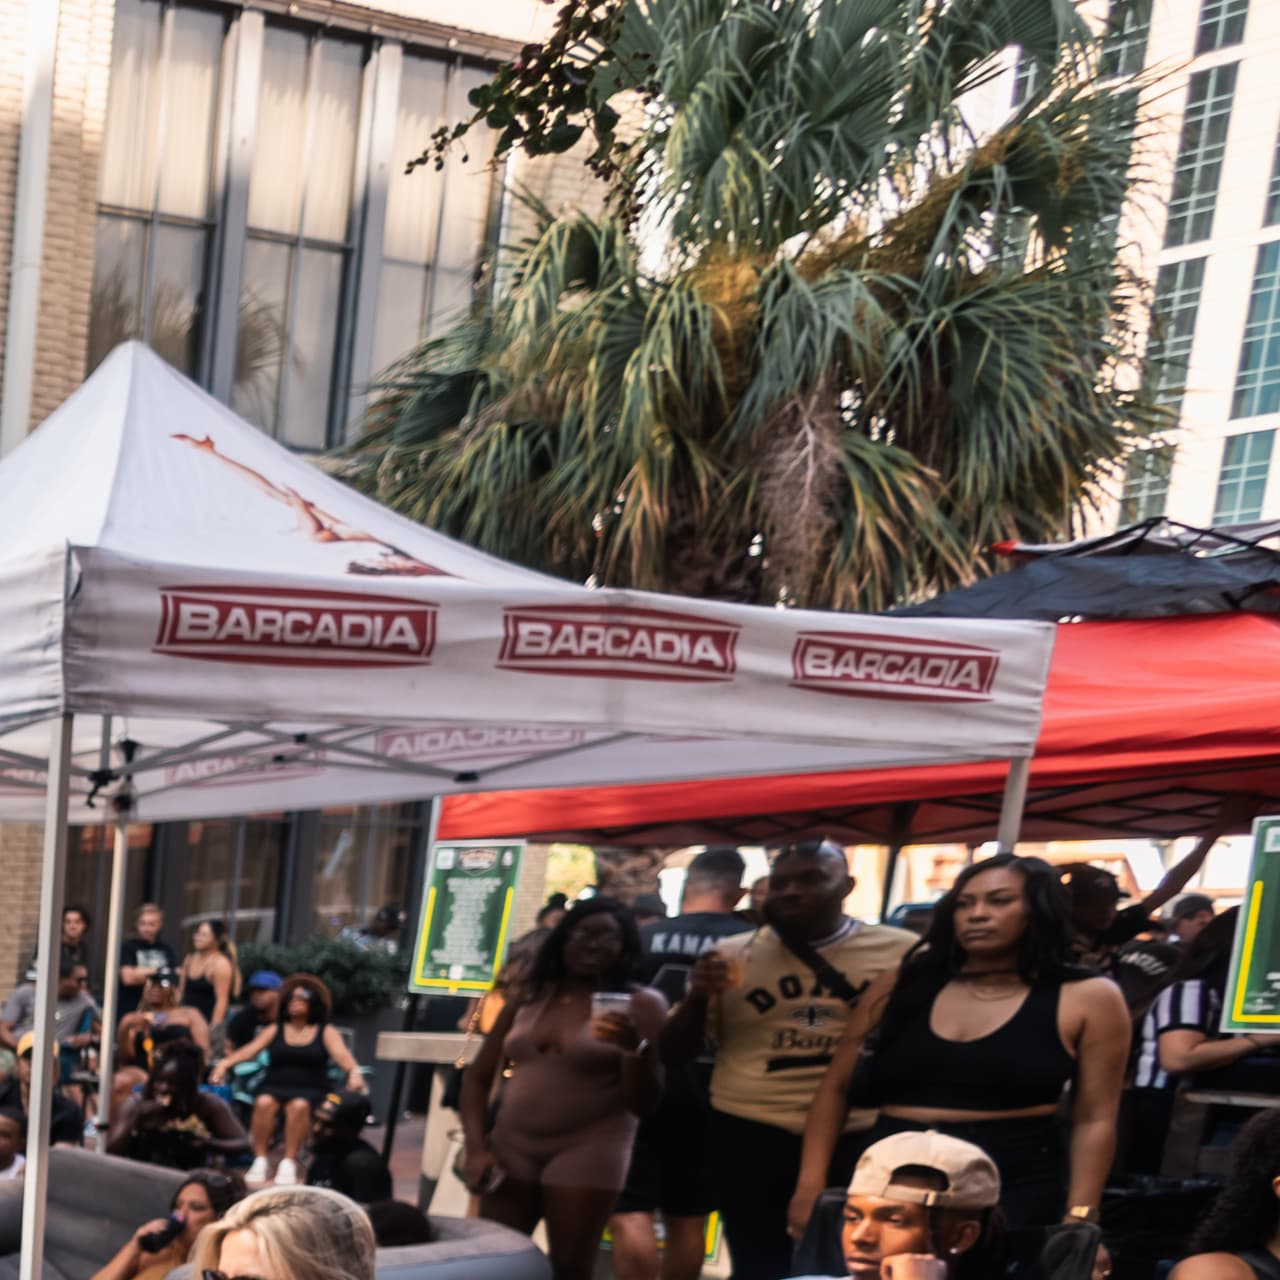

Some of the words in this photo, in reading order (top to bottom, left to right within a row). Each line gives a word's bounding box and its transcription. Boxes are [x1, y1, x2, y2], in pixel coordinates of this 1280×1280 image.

[175, 603, 421, 651] BARCADIA
[516, 622, 723, 668] BARCADIA
[802, 646, 981, 691] BARCADIA
